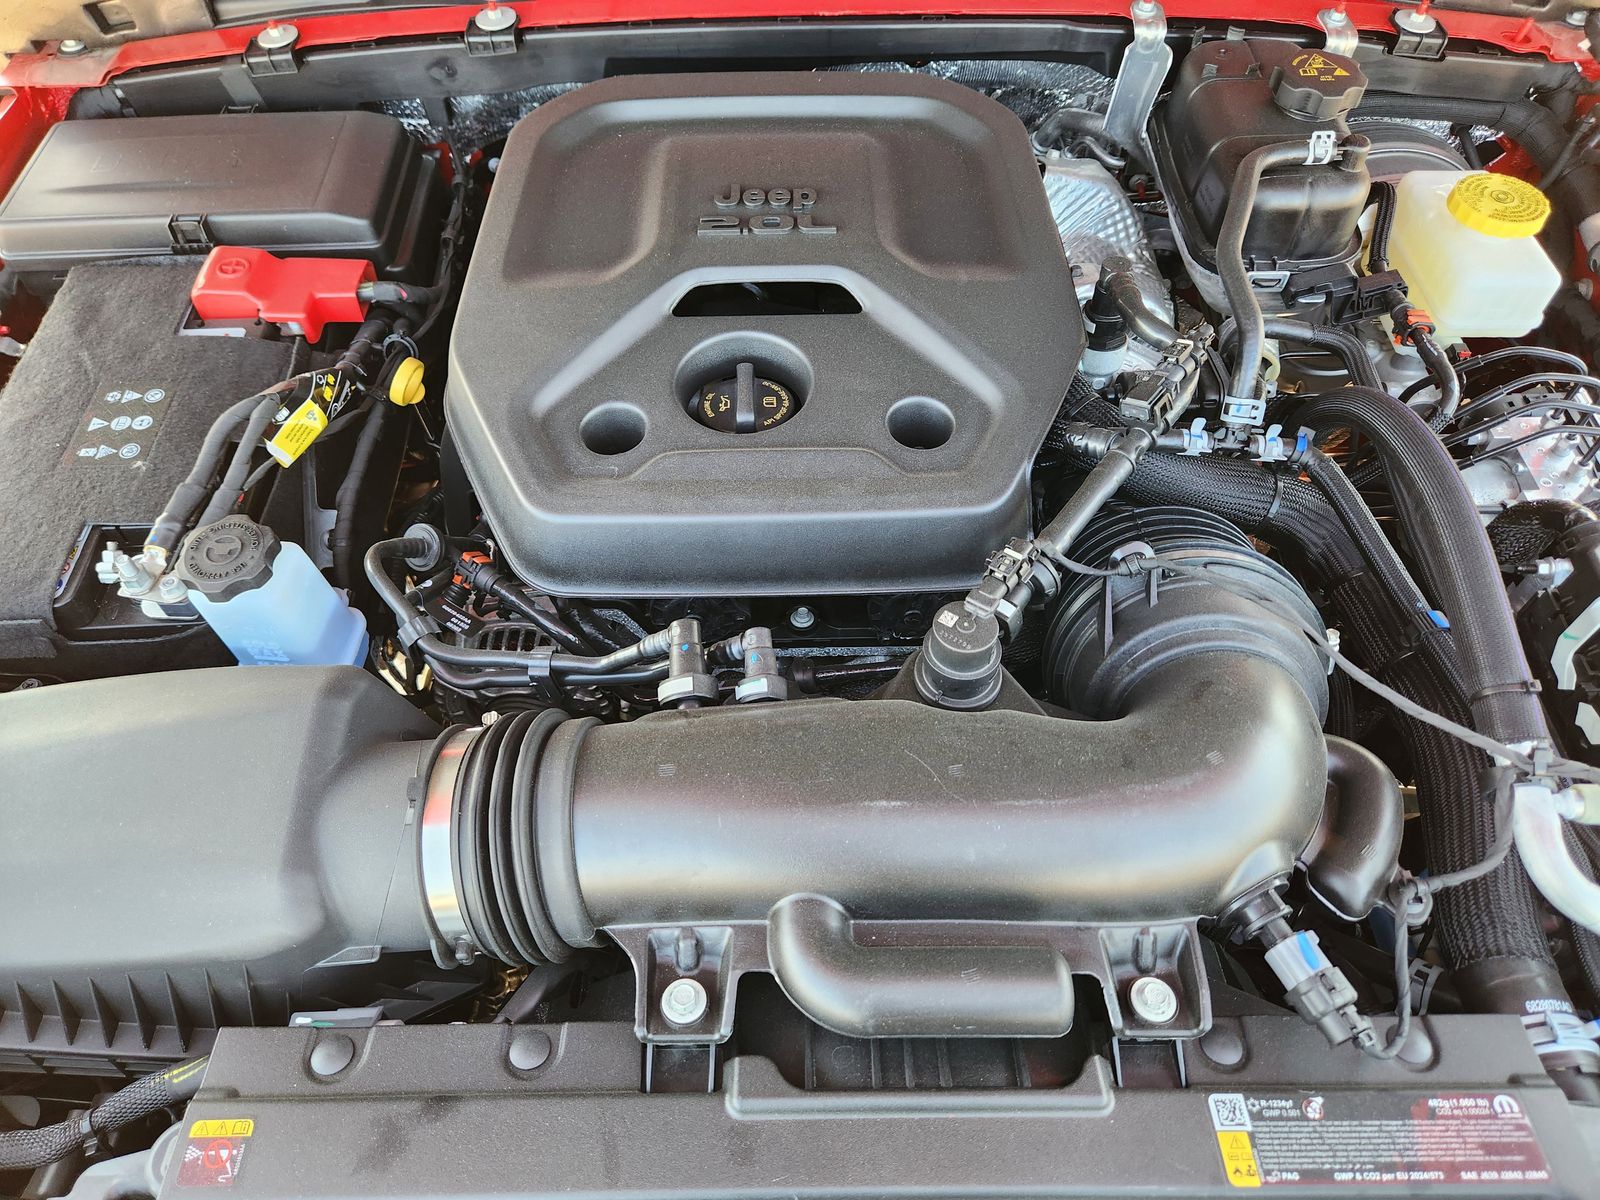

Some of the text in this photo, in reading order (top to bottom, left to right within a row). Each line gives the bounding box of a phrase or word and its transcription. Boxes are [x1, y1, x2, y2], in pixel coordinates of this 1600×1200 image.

[714, 183, 818, 212] Jeep
[697, 214, 837, 236] 2.0L
[1262, 1109, 1280, 1117] GWP
[1281, 1172, 1299, 1180] PAG
[1334, 1172, 1354, 1180] GWP
[1363, 1172, 1380, 1180] CO2
[1382, 1173, 1395, 1182] per
